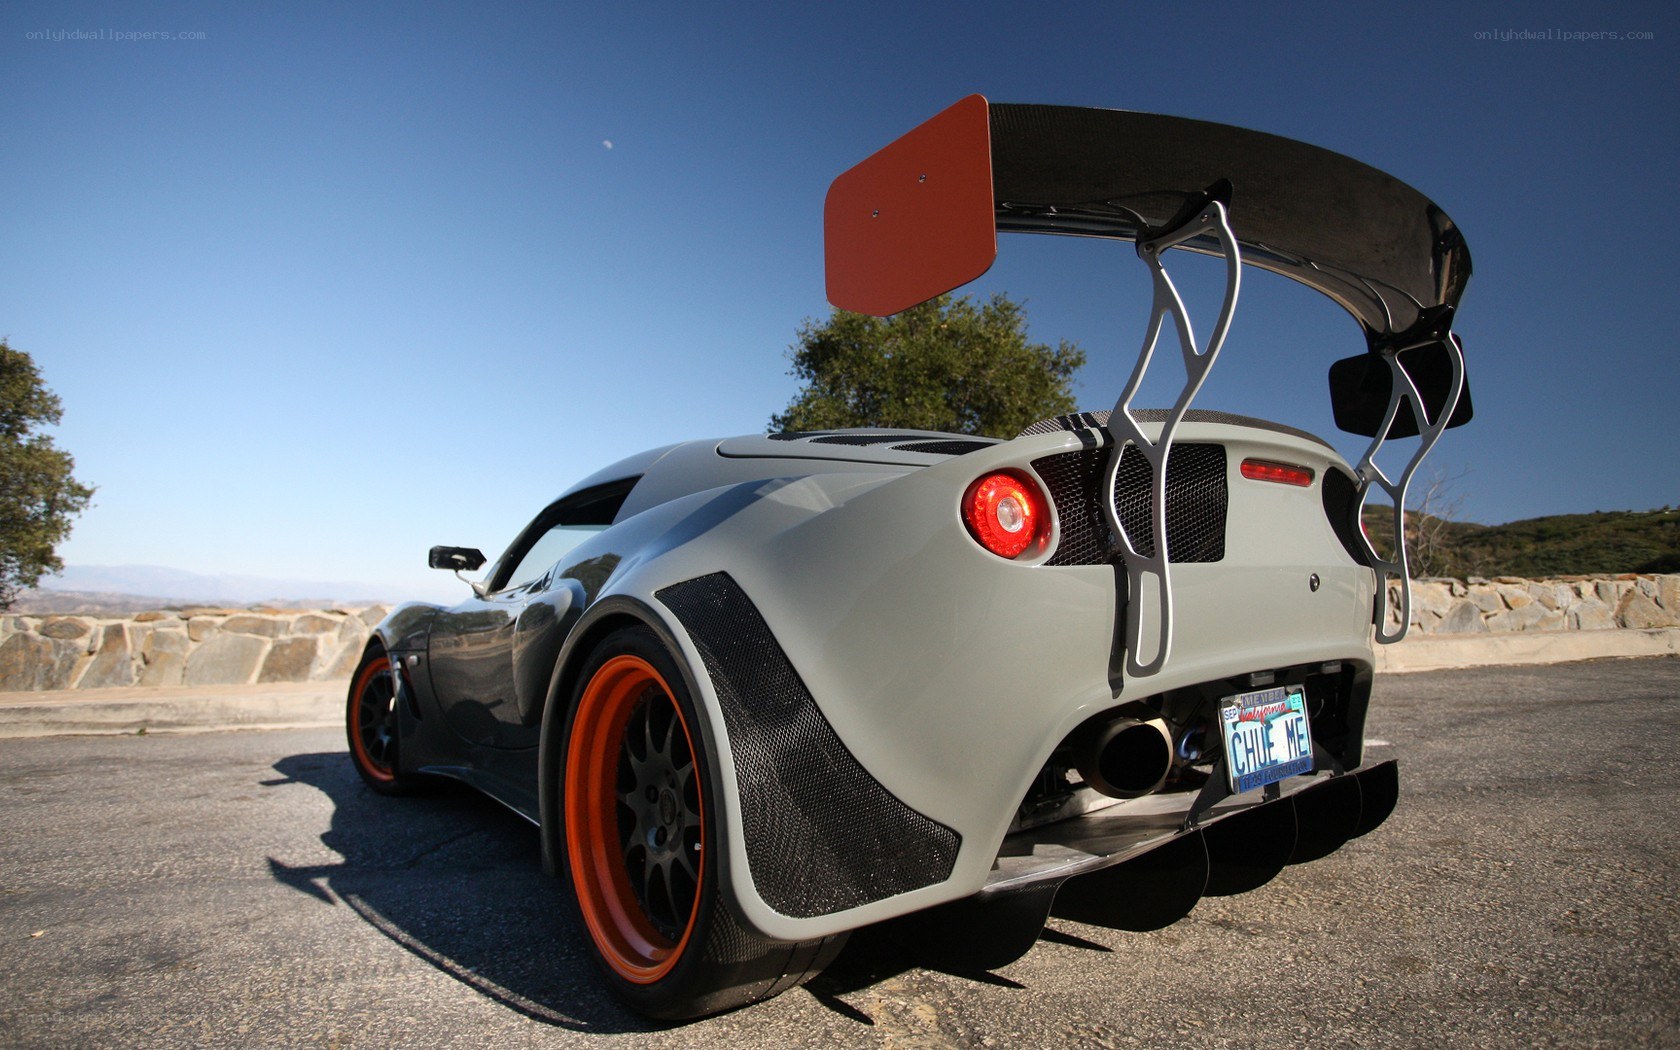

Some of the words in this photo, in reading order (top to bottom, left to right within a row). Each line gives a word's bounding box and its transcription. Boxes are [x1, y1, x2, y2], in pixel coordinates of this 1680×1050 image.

[1224, 708, 1237, 720] SEP
[1232, 723, 1278, 775] CHUE
[1285, 716, 1307, 759] ME
